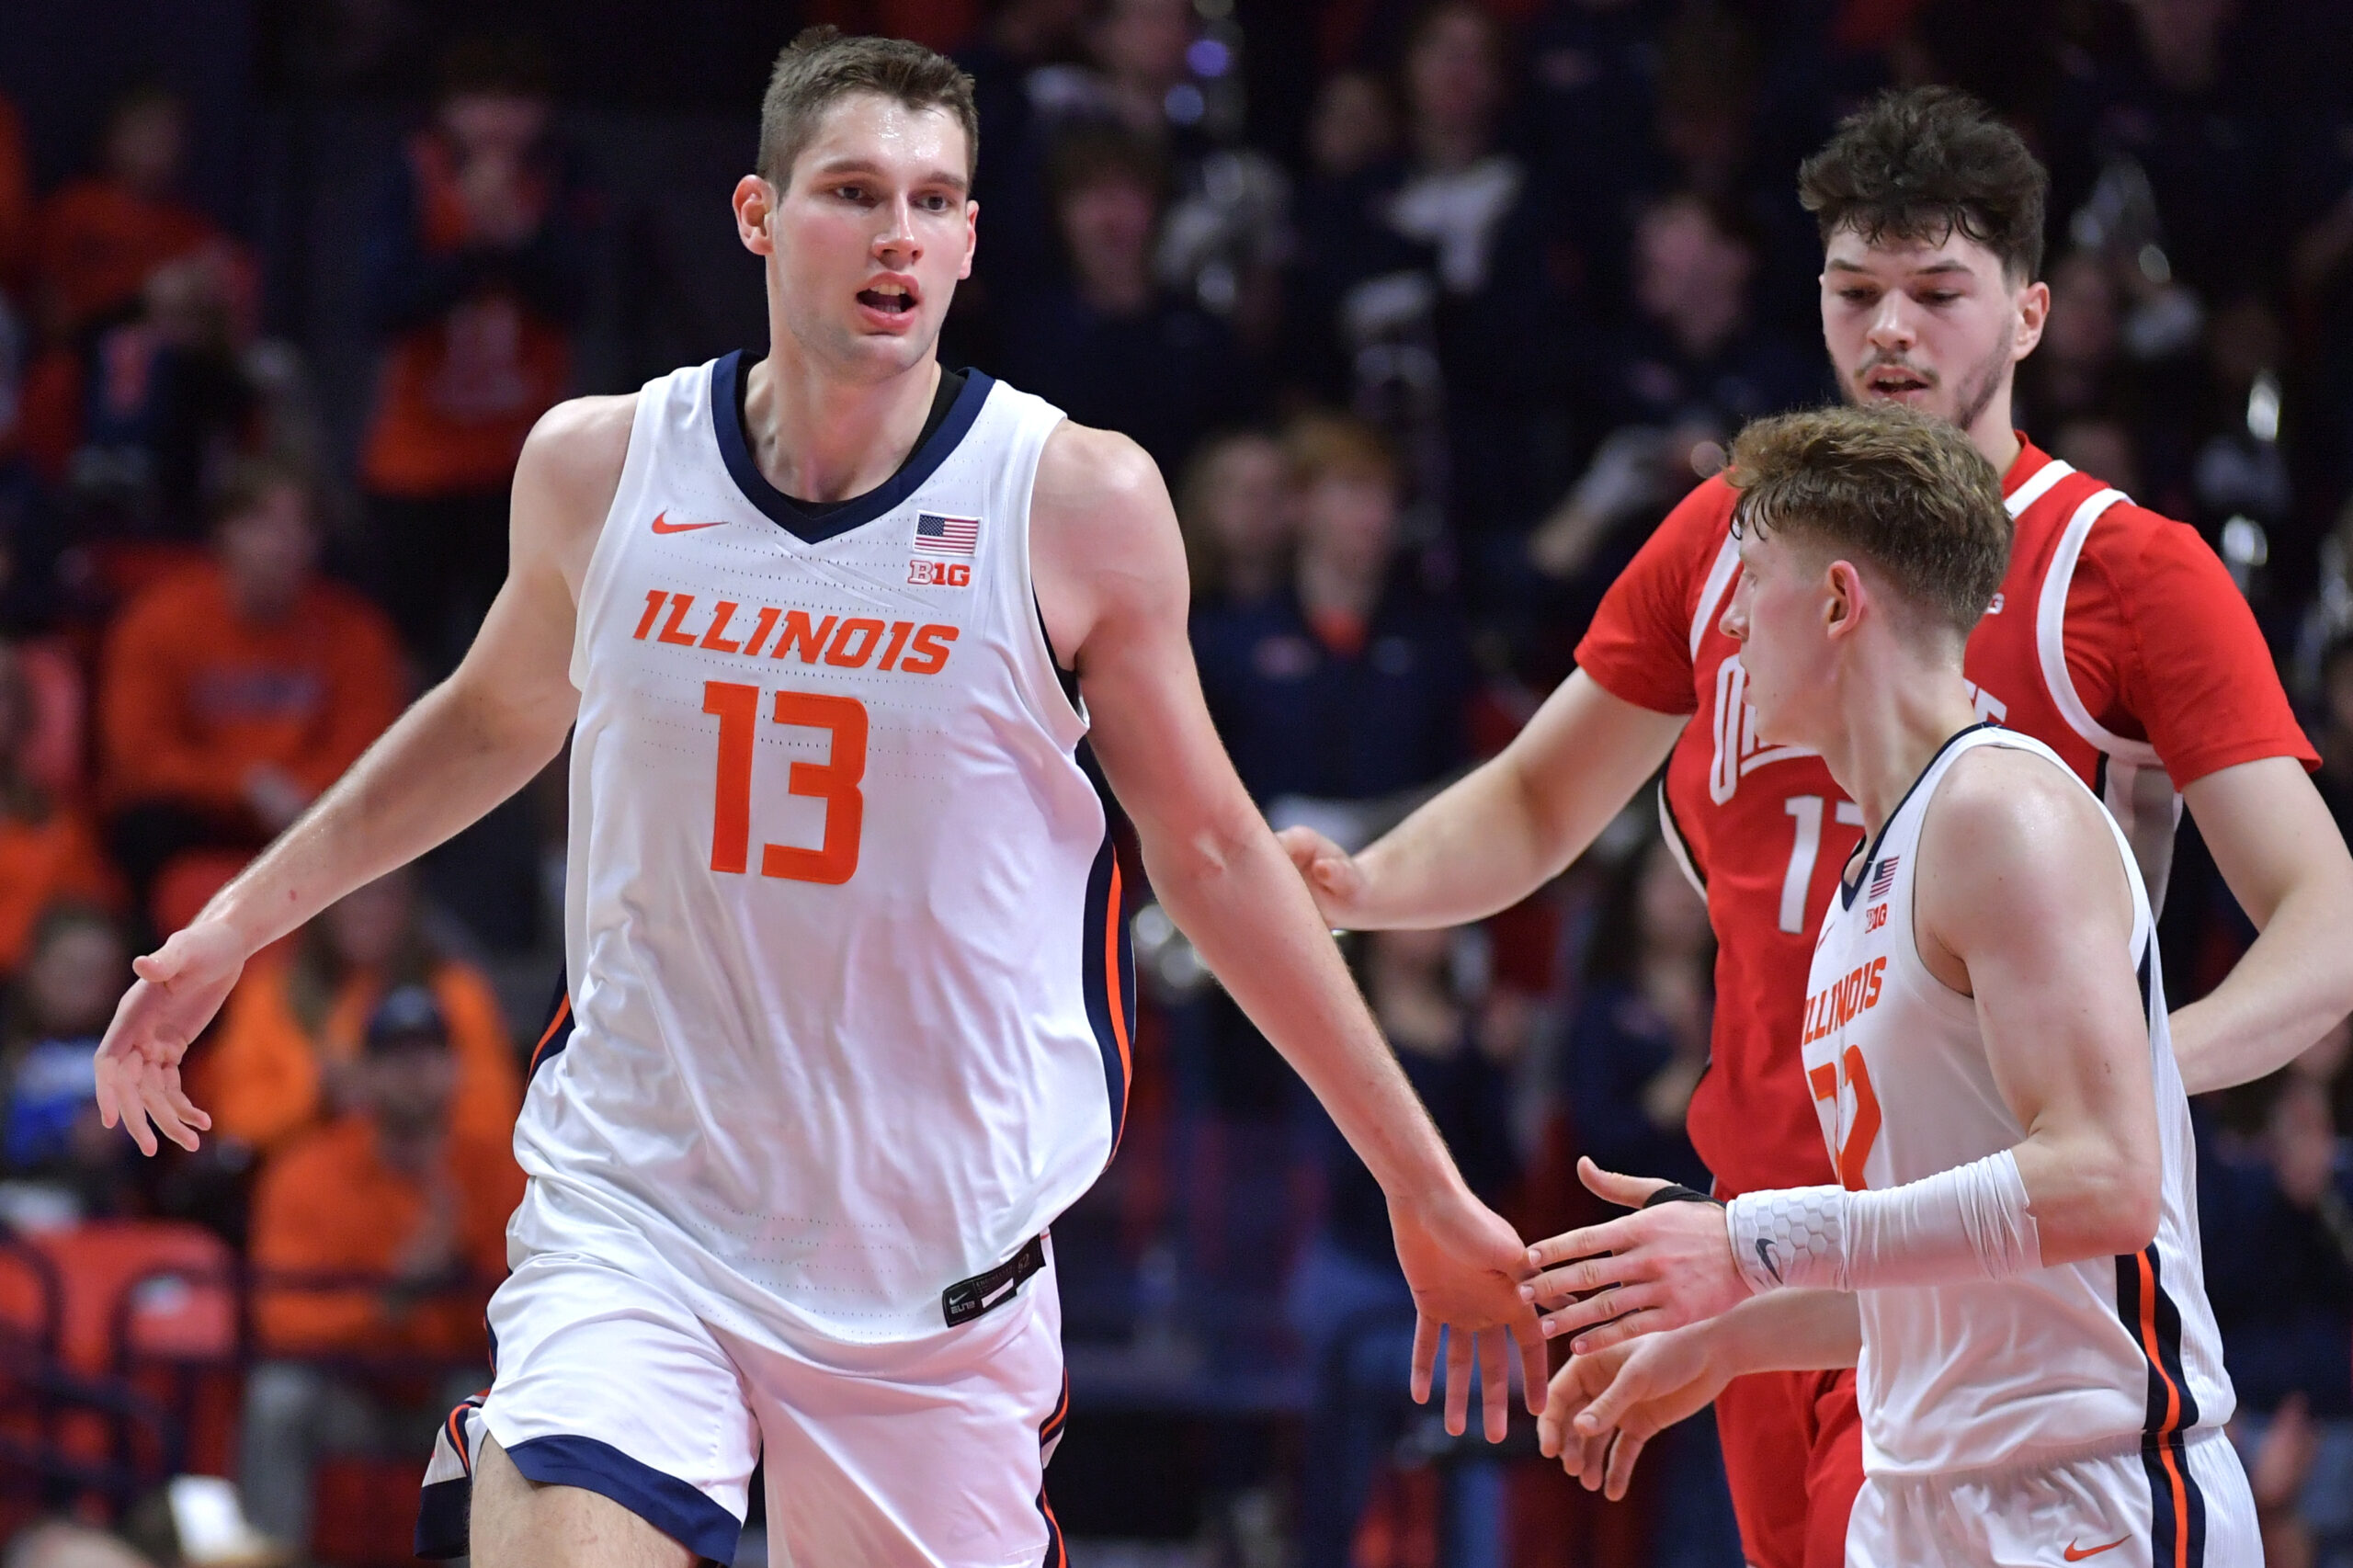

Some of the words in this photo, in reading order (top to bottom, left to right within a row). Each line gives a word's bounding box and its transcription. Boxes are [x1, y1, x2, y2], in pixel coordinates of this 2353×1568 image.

[632, 589, 960, 675] ILLINOIS
[702, 680, 869, 885] 13
[1779, 794, 1865, 935] 1
[1802, 956, 1888, 1047] ILLINOIS
[951, 1301, 975, 1314] ELITE
